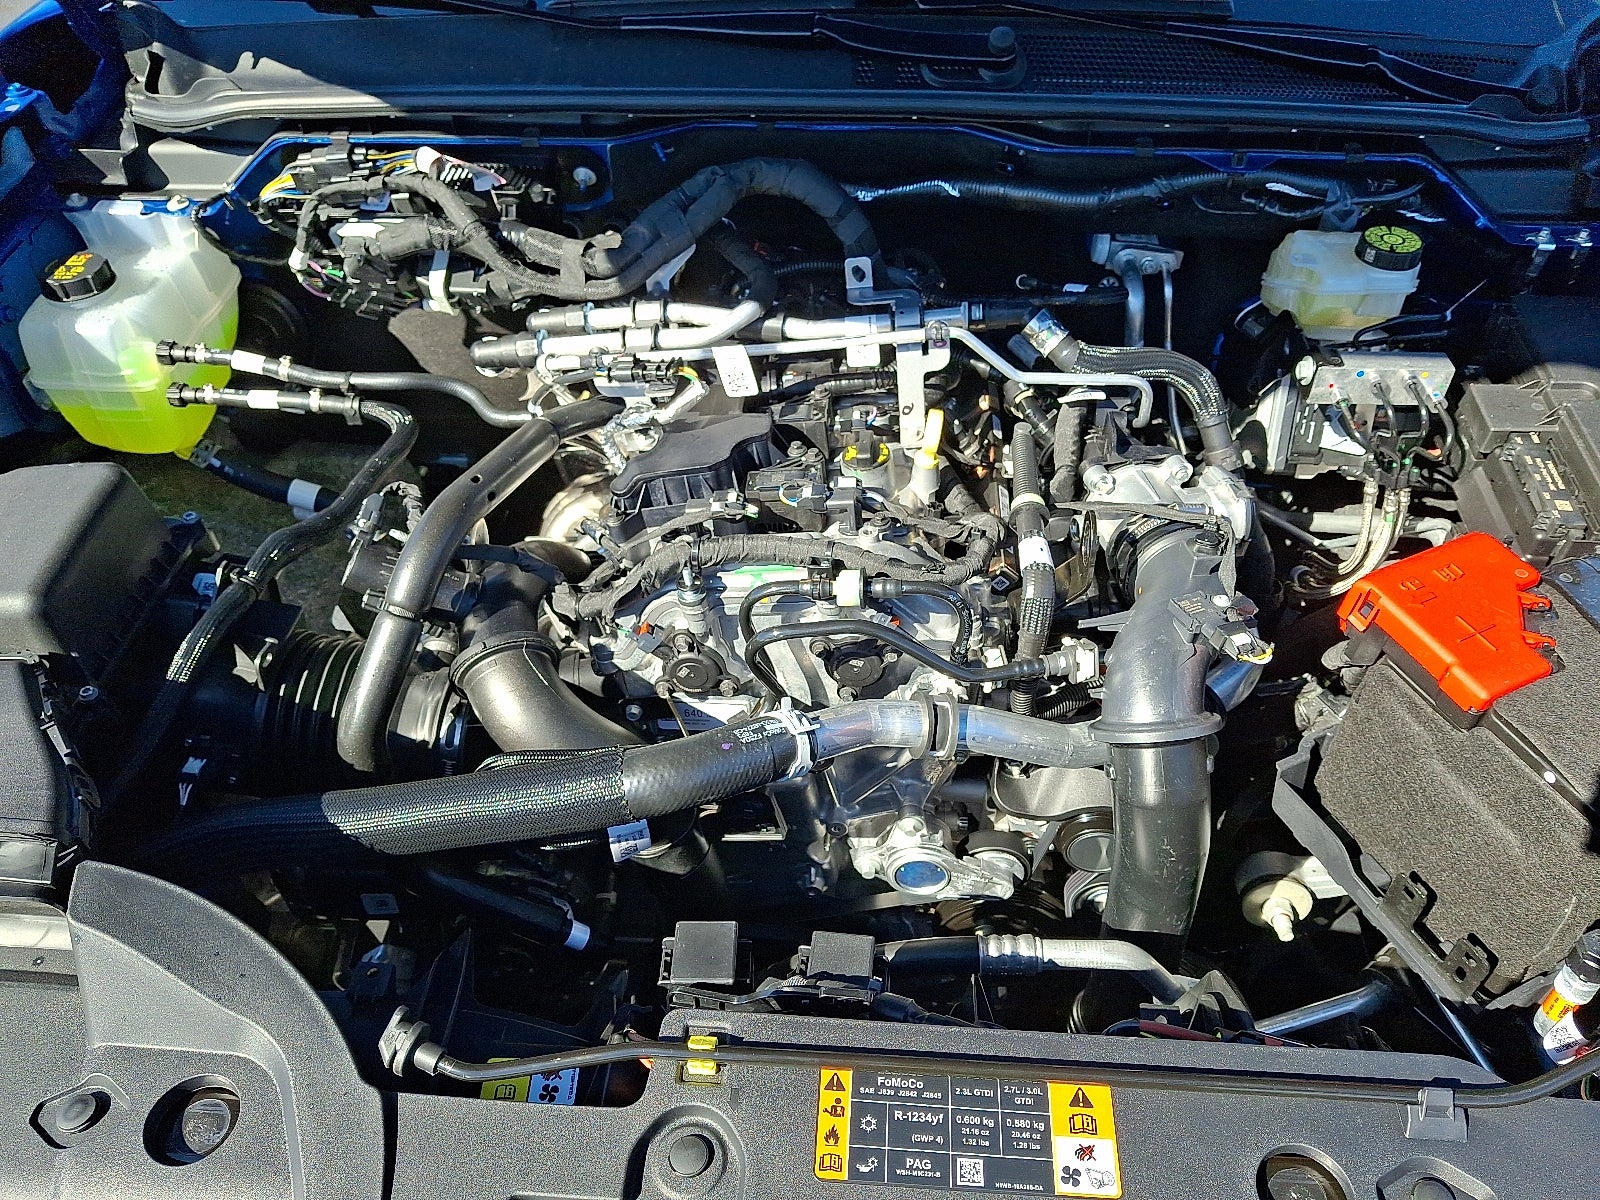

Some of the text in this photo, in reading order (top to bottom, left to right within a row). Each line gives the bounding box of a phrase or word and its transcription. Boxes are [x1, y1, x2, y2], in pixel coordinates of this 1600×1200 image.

[877, 1076, 924, 1089] FoMoCo
[955, 1087, 972, 1096] 2.3L
[1003, 1085, 1020, 1094] 2.7L
[1026, 1087, 1043, 1096] 3.0L
[894, 1110, 944, 1126] R-1234yf
[956, 1115, 995, 1128] 0.600 kg
[1033, 1120, 1045, 1132] kg
[911, 1133, 944, 1145] (GWP 4)
[962, 1137, 977, 1145] 1.32
[1012, 1141, 1041, 1150] 1.28 lbs
[906, 1157, 932, 1170] PAG
